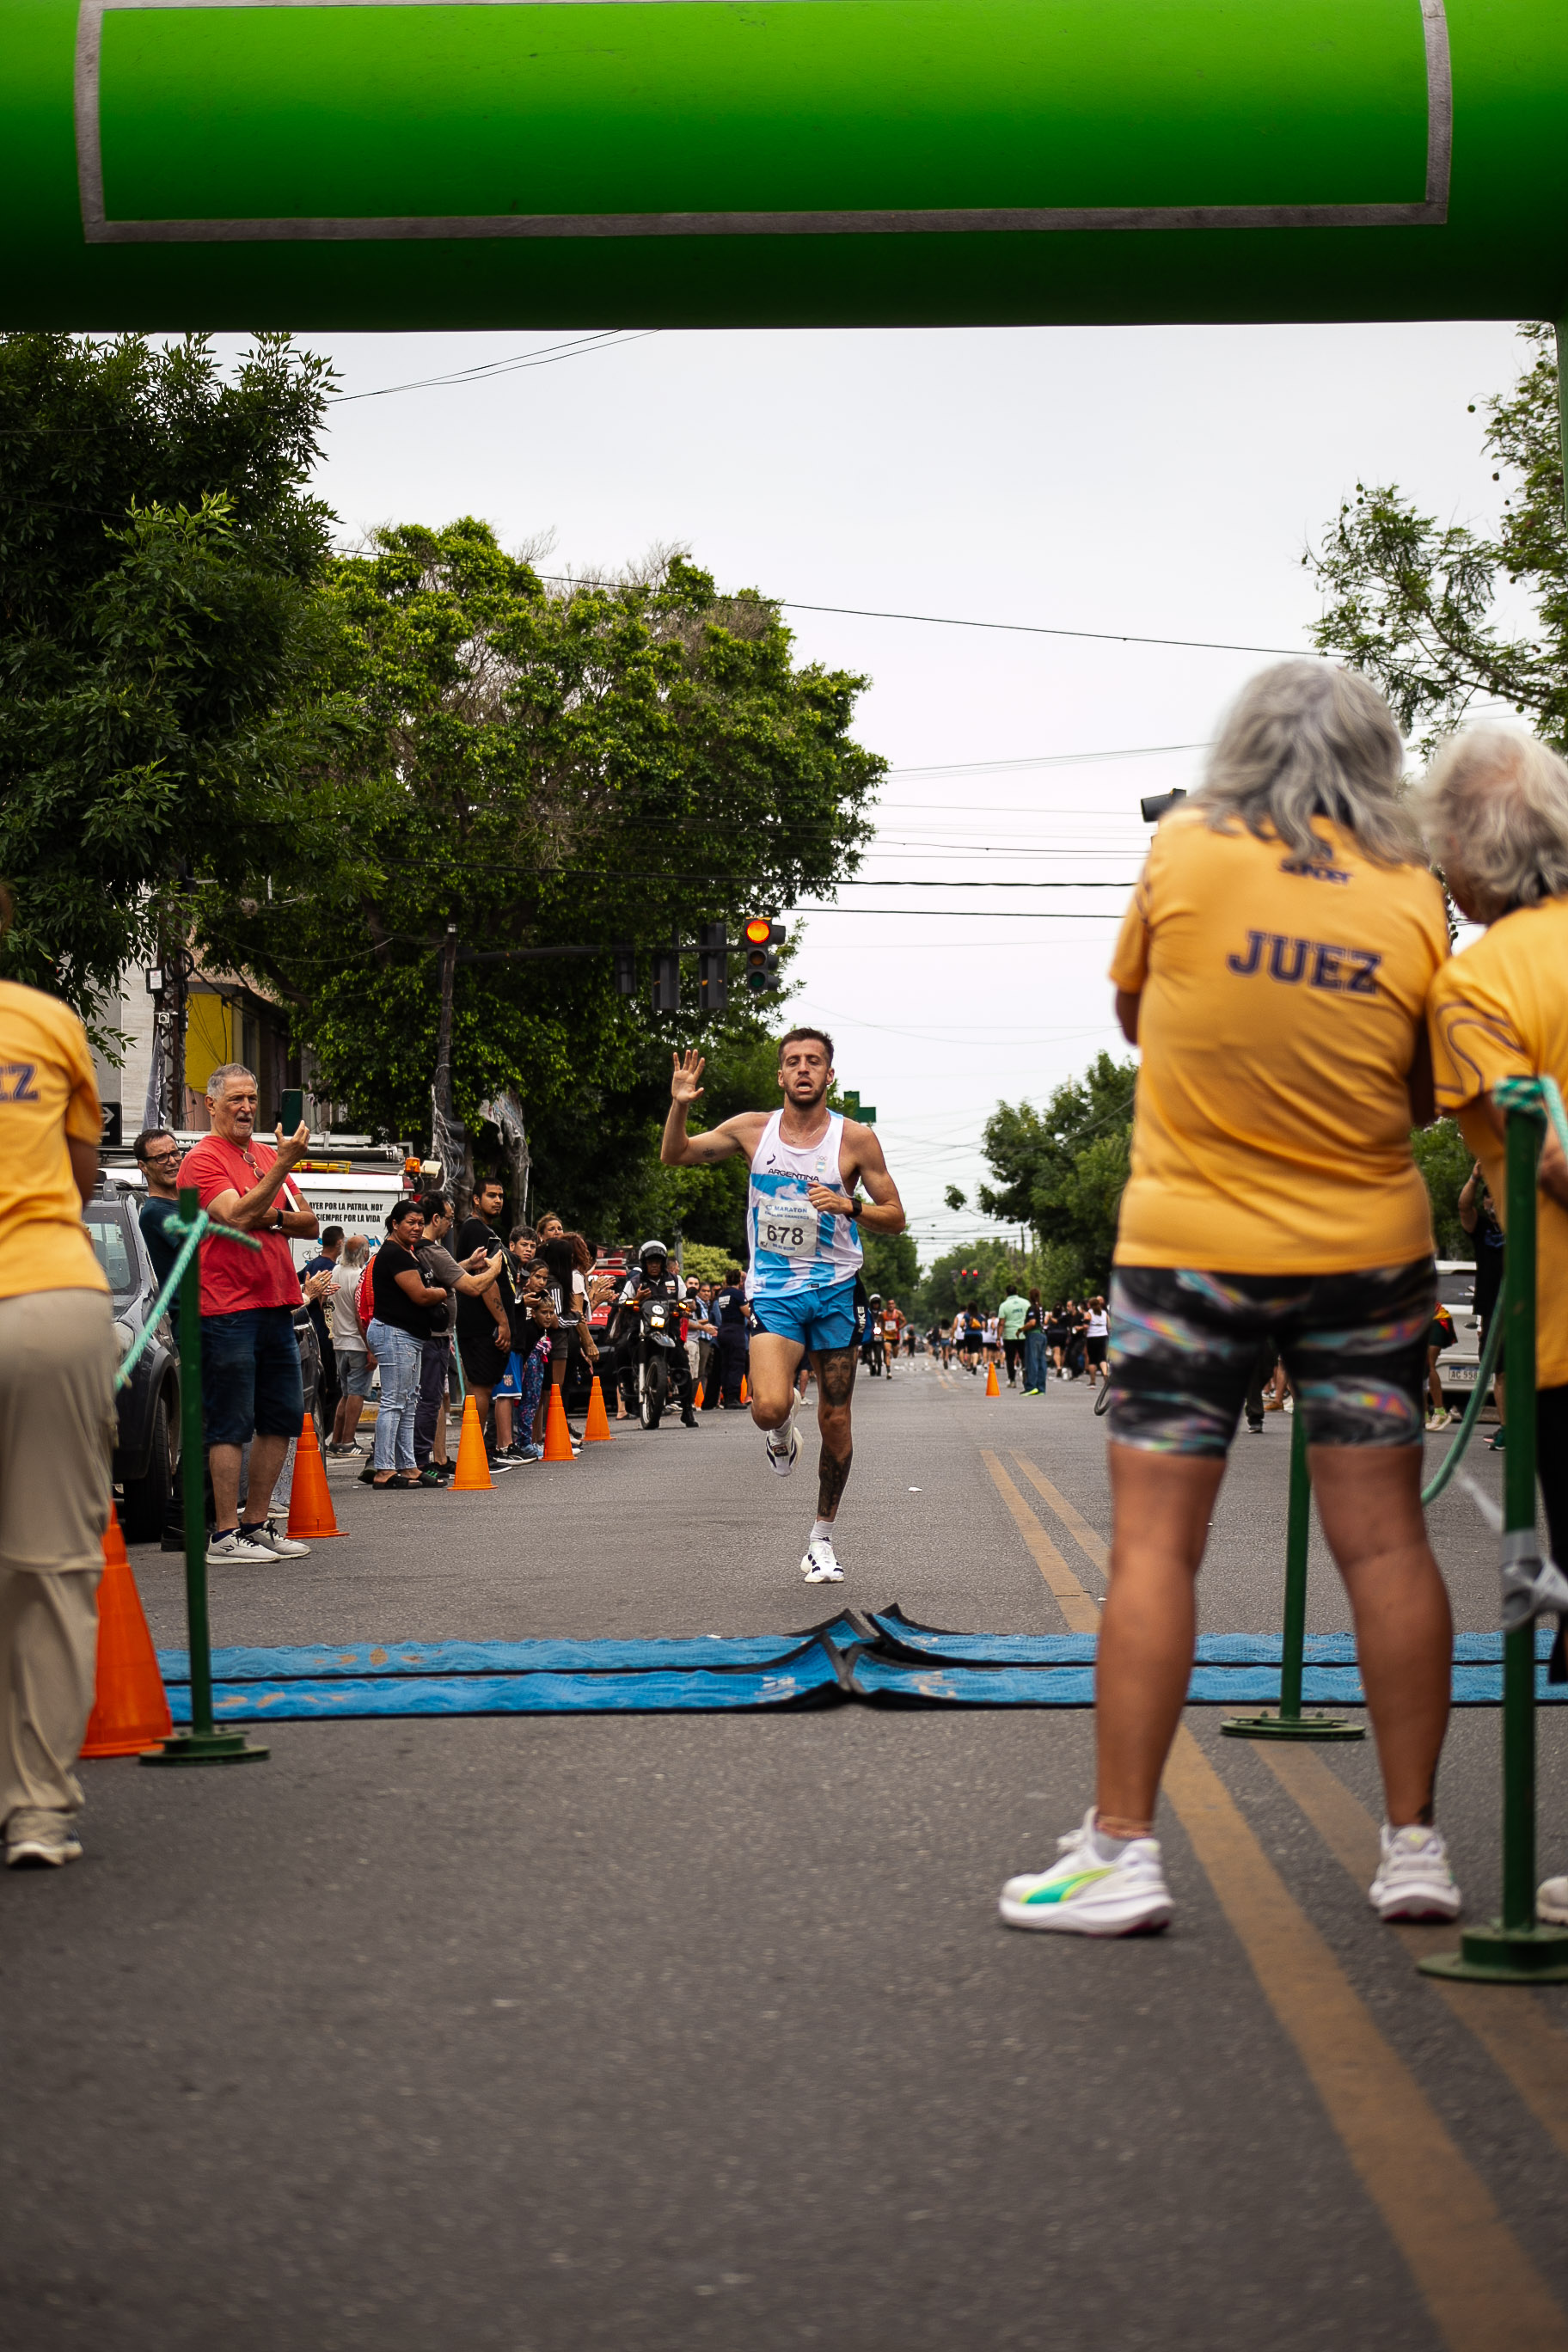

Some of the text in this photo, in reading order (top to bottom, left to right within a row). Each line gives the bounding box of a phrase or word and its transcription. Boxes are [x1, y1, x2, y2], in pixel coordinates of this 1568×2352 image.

[1227, 929, 1382, 997] JUEZ
[768, 1168, 820, 1182] ARGENTINA
[324, 1202, 337, 1210] POR
[347, 1203, 370, 1211] PATRIA,
[344, 1214, 356, 1222] POR
[767, 1224, 804, 1246] 678
[857, 1306, 867, 1333] NIKE
